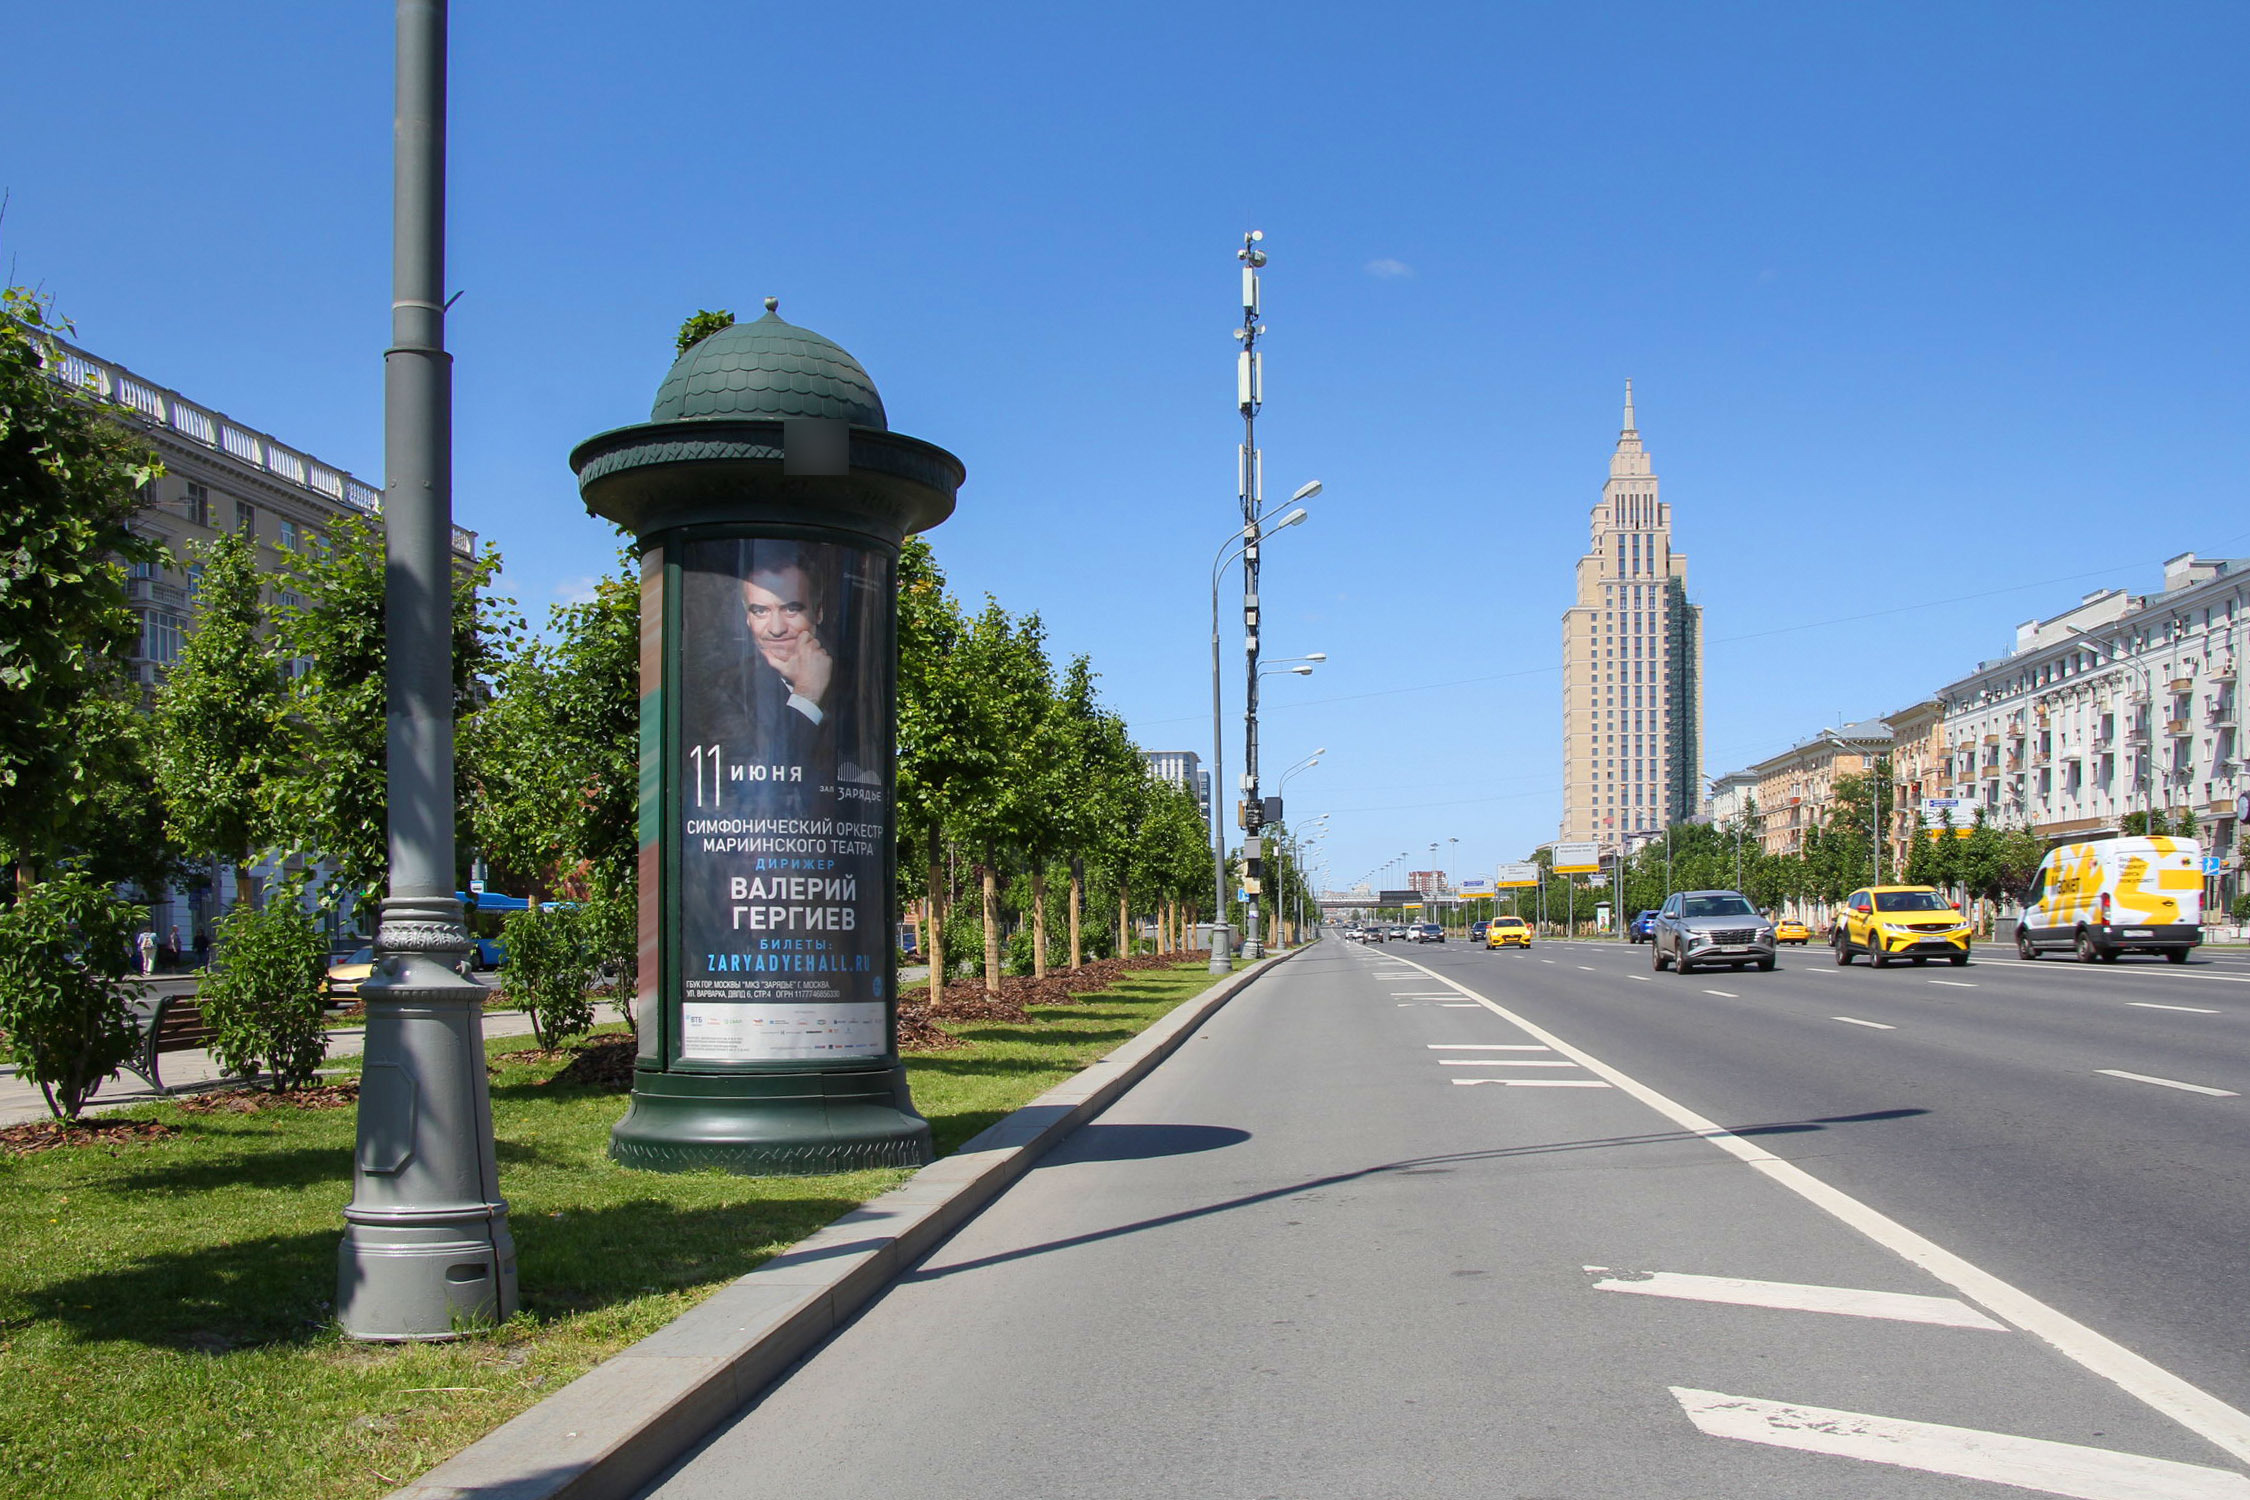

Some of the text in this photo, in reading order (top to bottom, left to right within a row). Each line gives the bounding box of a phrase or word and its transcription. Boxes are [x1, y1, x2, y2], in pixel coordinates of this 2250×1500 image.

[690, 744, 721, 808] 11
[819, 785, 882, 803] ЗАЛ ЗАРЯДЬЕ
[687, 817, 884, 840] СИМФОНИЧЕСКИЙ ОРКЕСТР
[703, 837, 874, 856] МАРИИНСКОГО ТЕАТРА
[755, 858, 835, 872] ДИРИЖЕР
[730, 873, 857, 901] ВАЛЕРИЙ
[732, 906, 856, 931] ГЕРГИЕВ
[759, 939, 833, 950] БИЛЕТЫ:
[707, 954, 871, 972] ZARYADYEHALL.RU
[714, 980, 741, 989] МОСКВЫ
[775, 990, 794, 998] ОГРН
